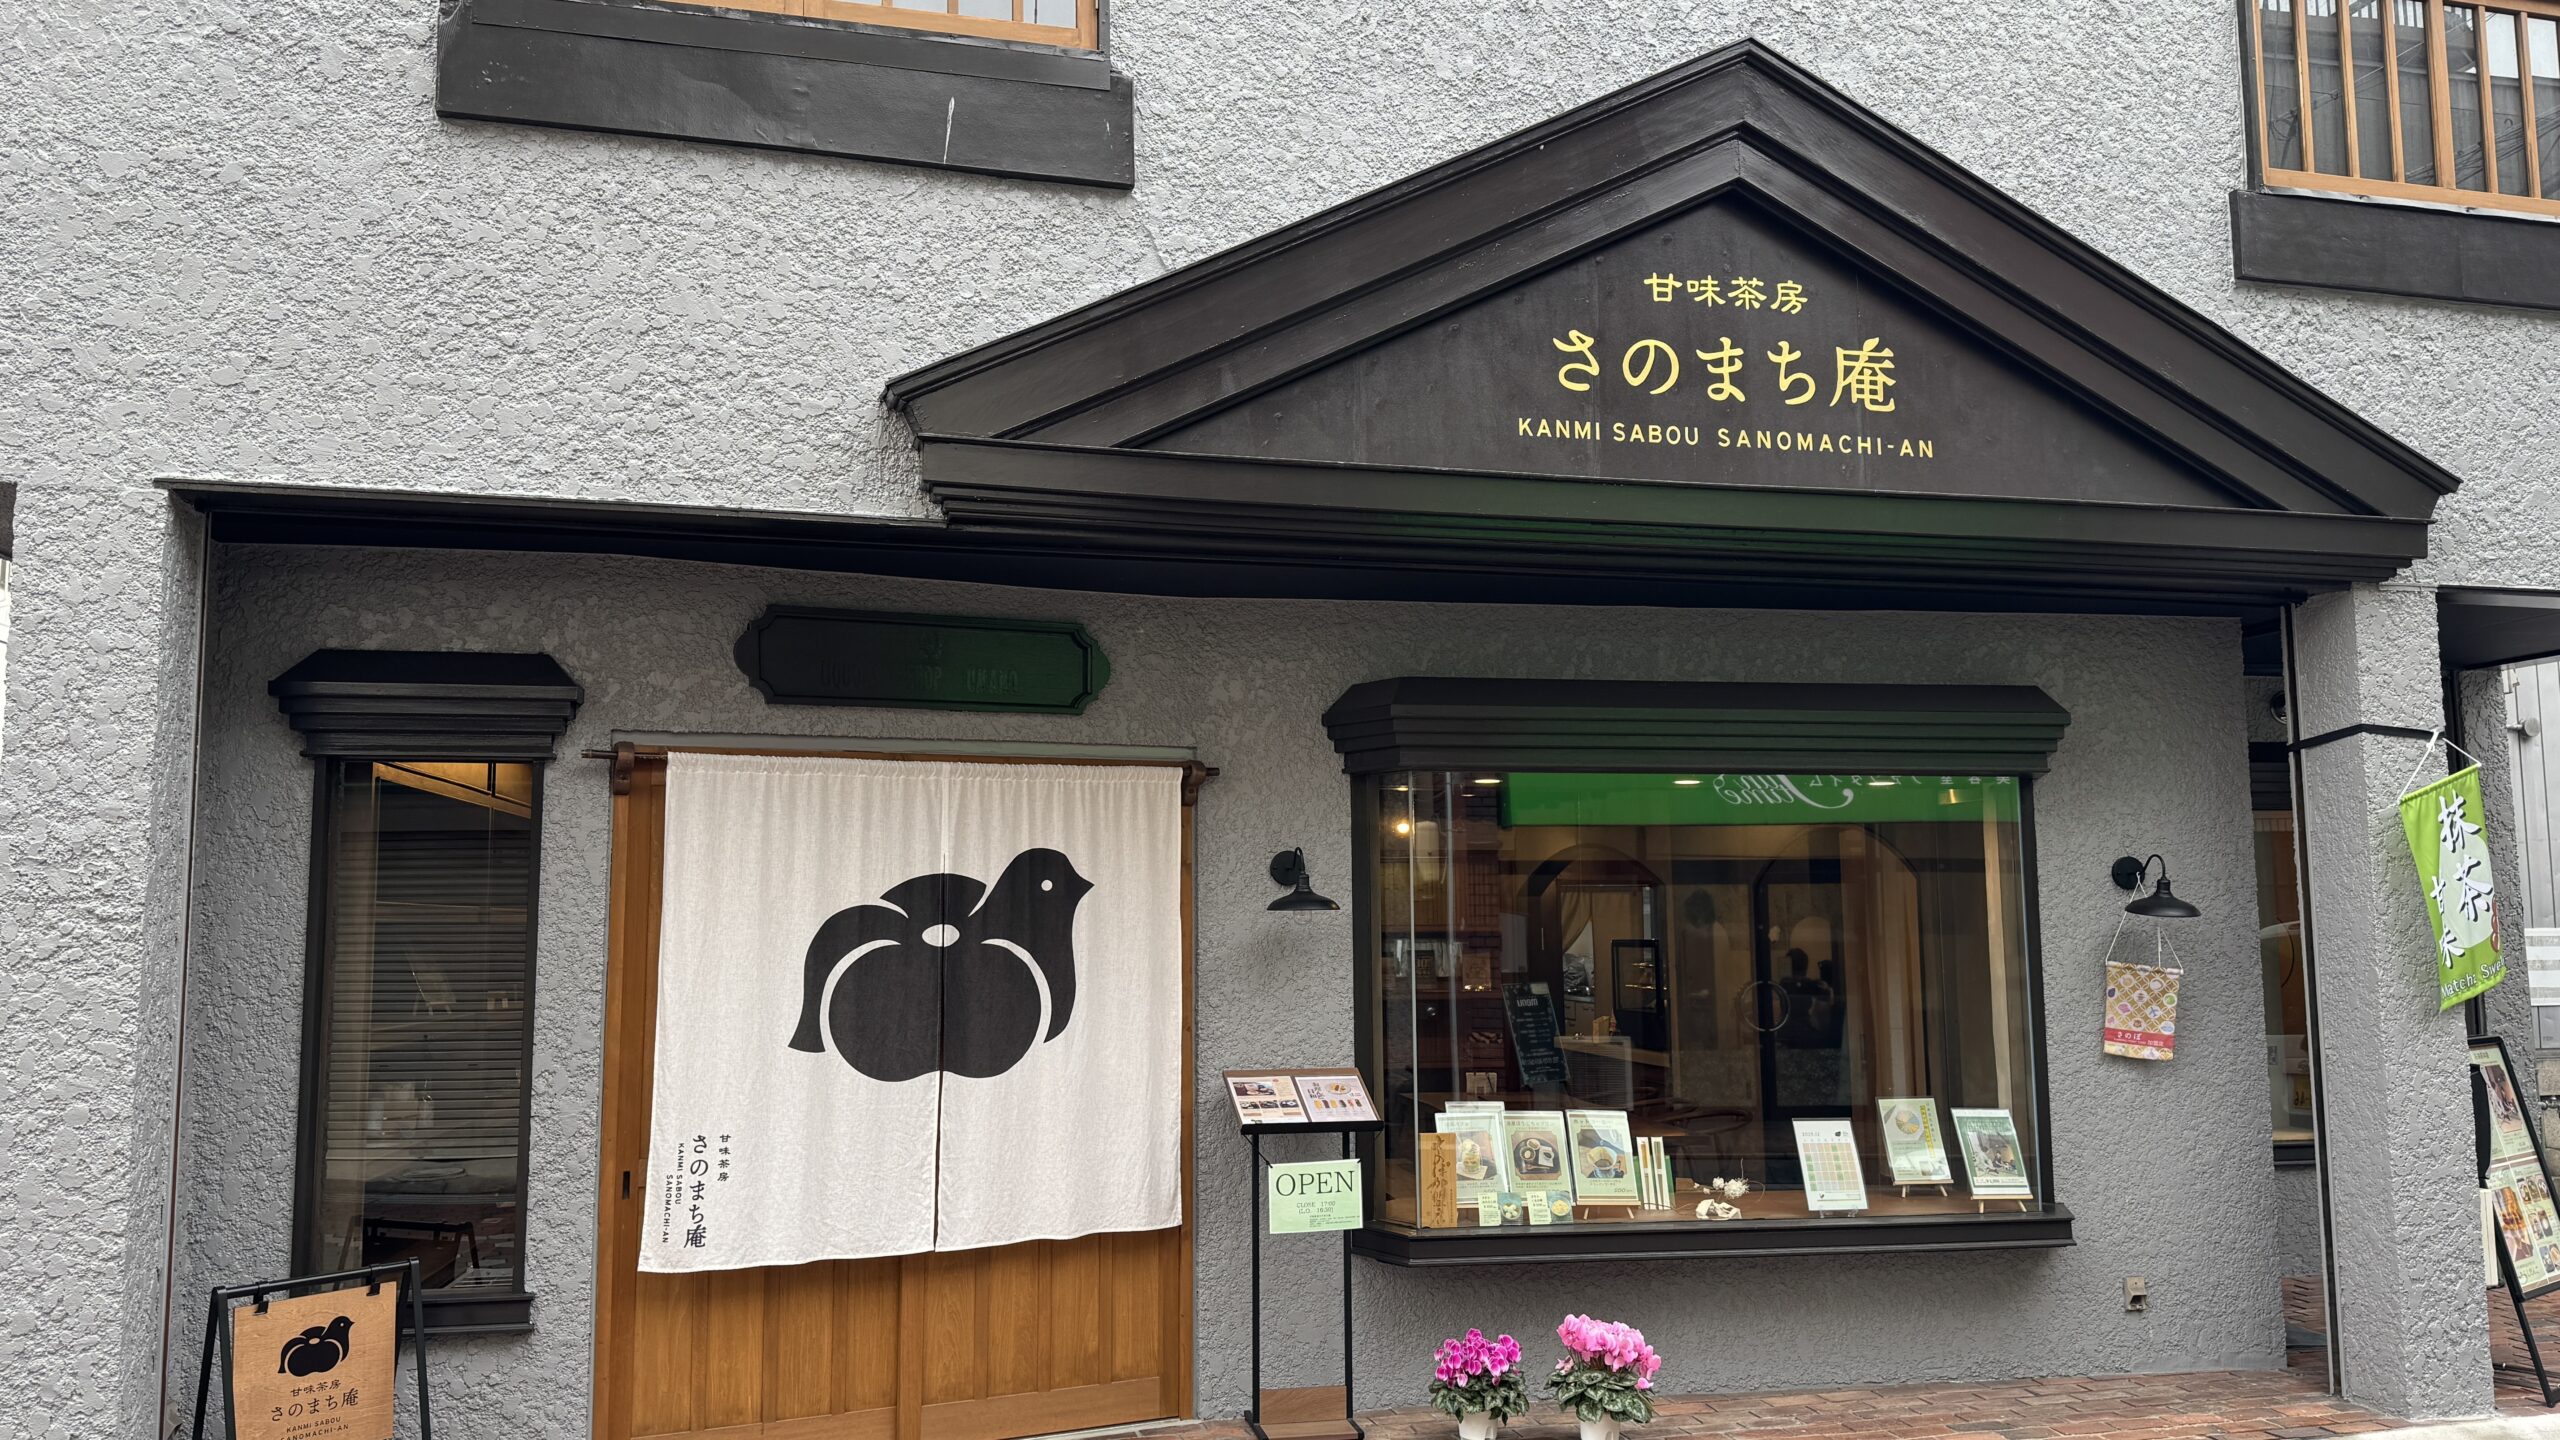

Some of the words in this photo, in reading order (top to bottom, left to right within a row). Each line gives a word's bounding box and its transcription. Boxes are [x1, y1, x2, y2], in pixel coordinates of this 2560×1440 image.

[1643, 272, 1808, 315] 甘味茶房
[1552, 329, 1897, 413] さのまち庵
[1518, 417, 1602, 441] KANMI
[1612, 422, 1700, 446] SABOU
[1717, 427, 1935, 459] SANOMACHI-AN
[2437, 789, 2495, 922] 抹茶
[717, 1134, 732, 1182] 甘味茶房
[675, 1174, 683, 1205] SABOU
[684, 1134, 709, 1249] さのまち庵
[1275, 1170, 1356, 1197] OPEN
[662, 1174, 673, 1243] SANOMACHI-AN
[271, 1387, 359, 1422] さのまち庵
[290, 1379, 342, 1397] 甘味茶房
[286, 1423, 312, 1434] KANMI
[314, 1416, 341, 1427] SABOU
